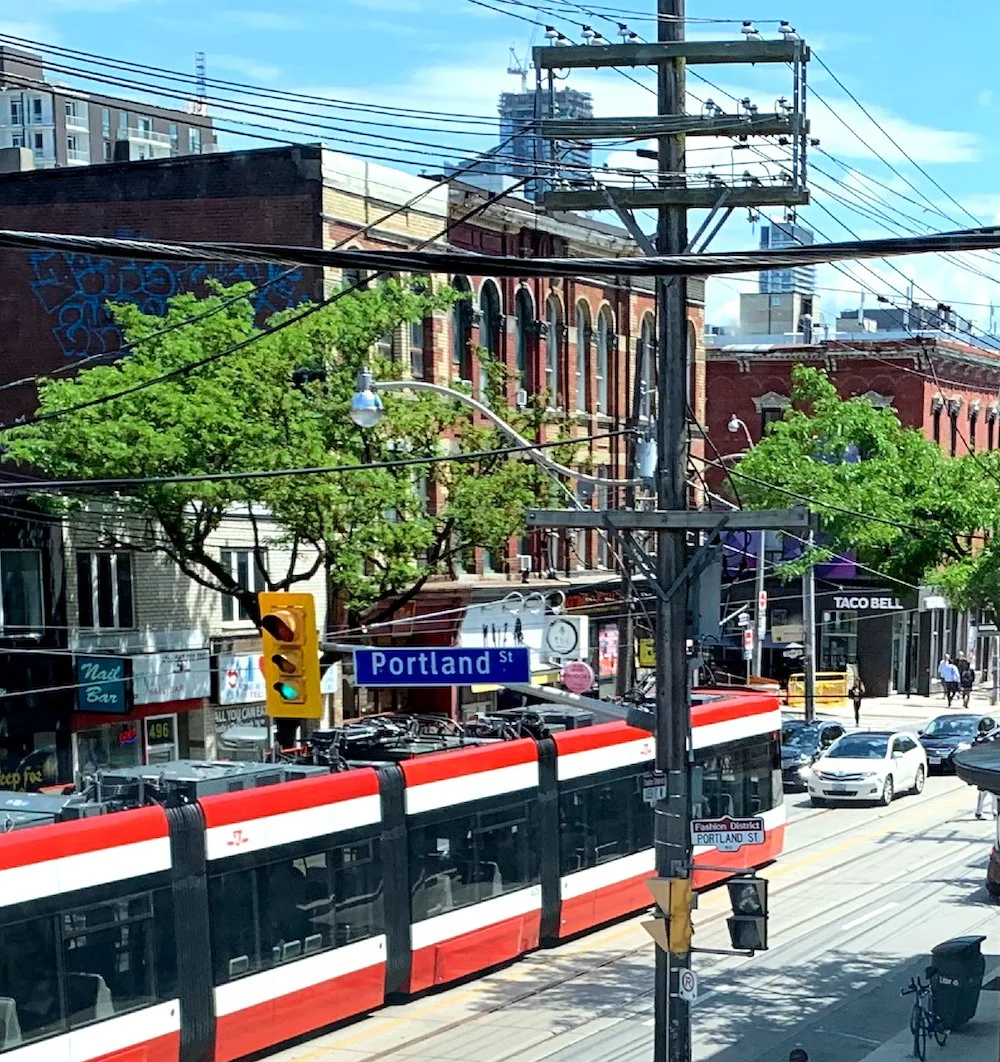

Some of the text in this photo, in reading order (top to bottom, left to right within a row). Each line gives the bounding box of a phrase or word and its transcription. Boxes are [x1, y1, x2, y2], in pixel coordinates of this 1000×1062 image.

[833, 597, 904, 610] TACO BELL
[371, 651, 513, 676] Portland St
[80, 662, 121, 681] Nail
[85, 686, 118, 703] Bar
[226, 708, 241, 722] YOU
[149, 723, 169, 739] 496
[694, 820, 761, 832] Fashion District
[696, 832, 759, 844] PORTLAND ST
